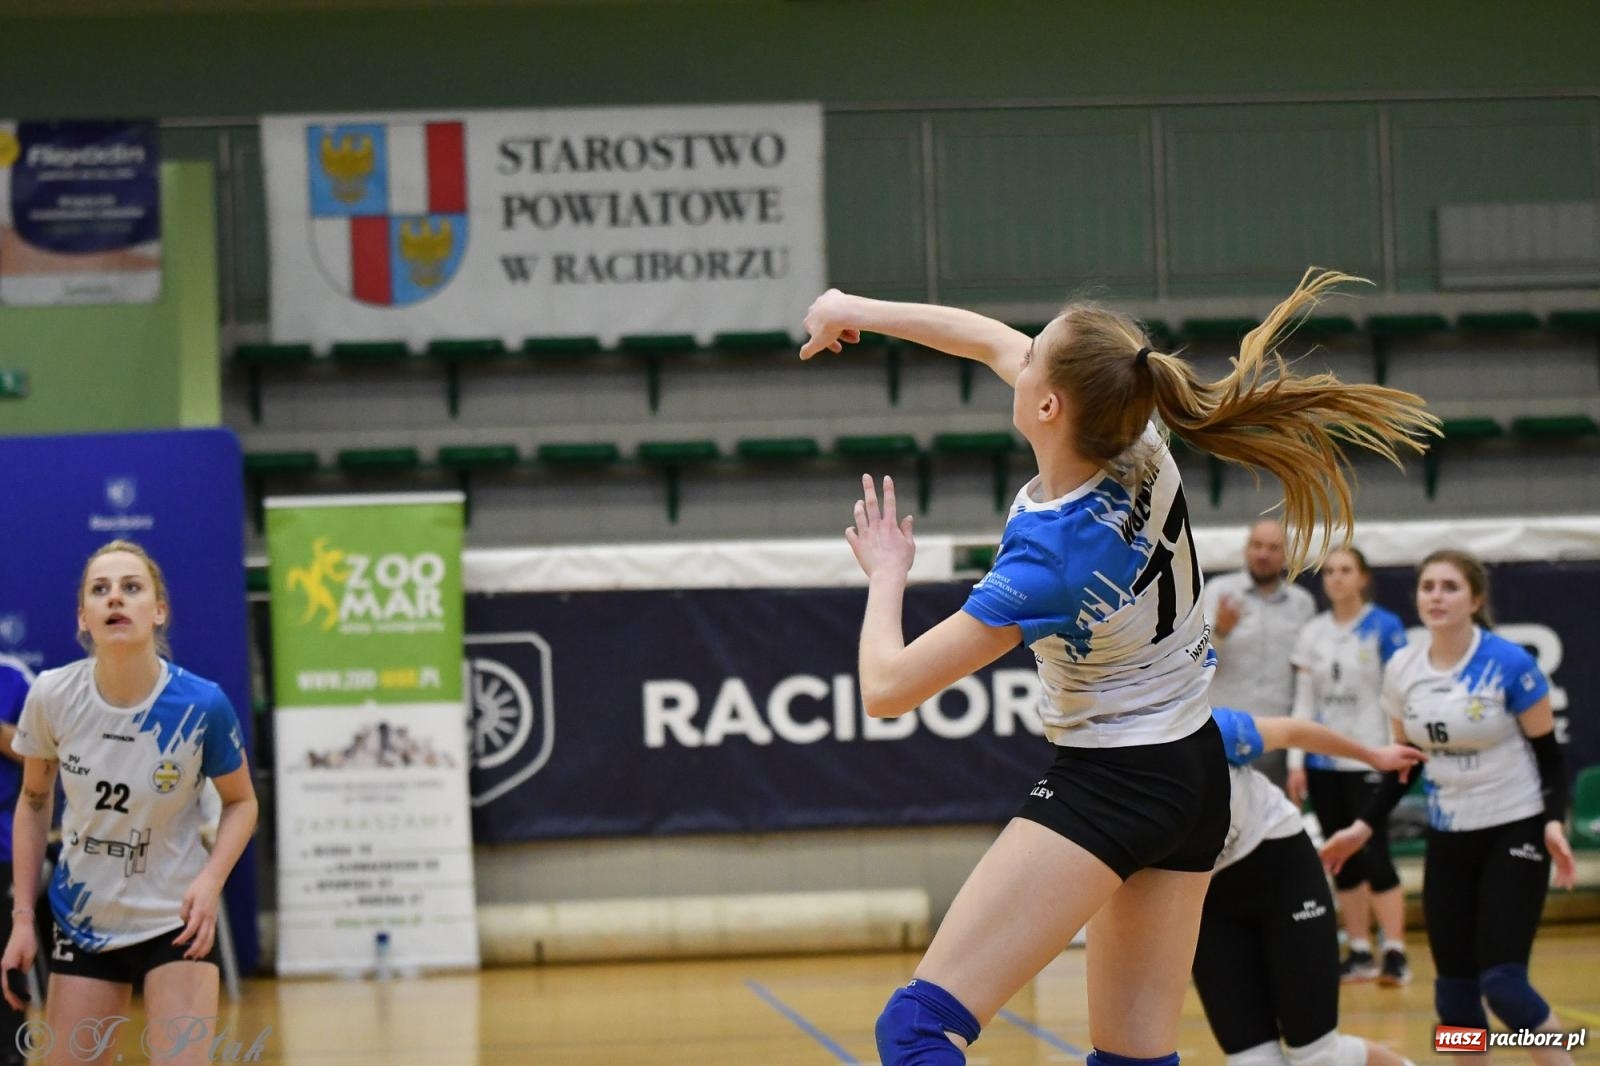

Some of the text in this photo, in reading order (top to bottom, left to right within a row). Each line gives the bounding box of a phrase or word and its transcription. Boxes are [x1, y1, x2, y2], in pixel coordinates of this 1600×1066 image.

[497, 128, 786, 174] STAROSTWO
[502, 187, 784, 230] POWIATOWE
[500, 247, 791, 285] W RACIBORZU
[345, 552, 447, 591] ZOO
[340, 586, 444, 621] MAR
[1425, 721, 1450, 744] 16
[95, 780, 131, 815] 22
